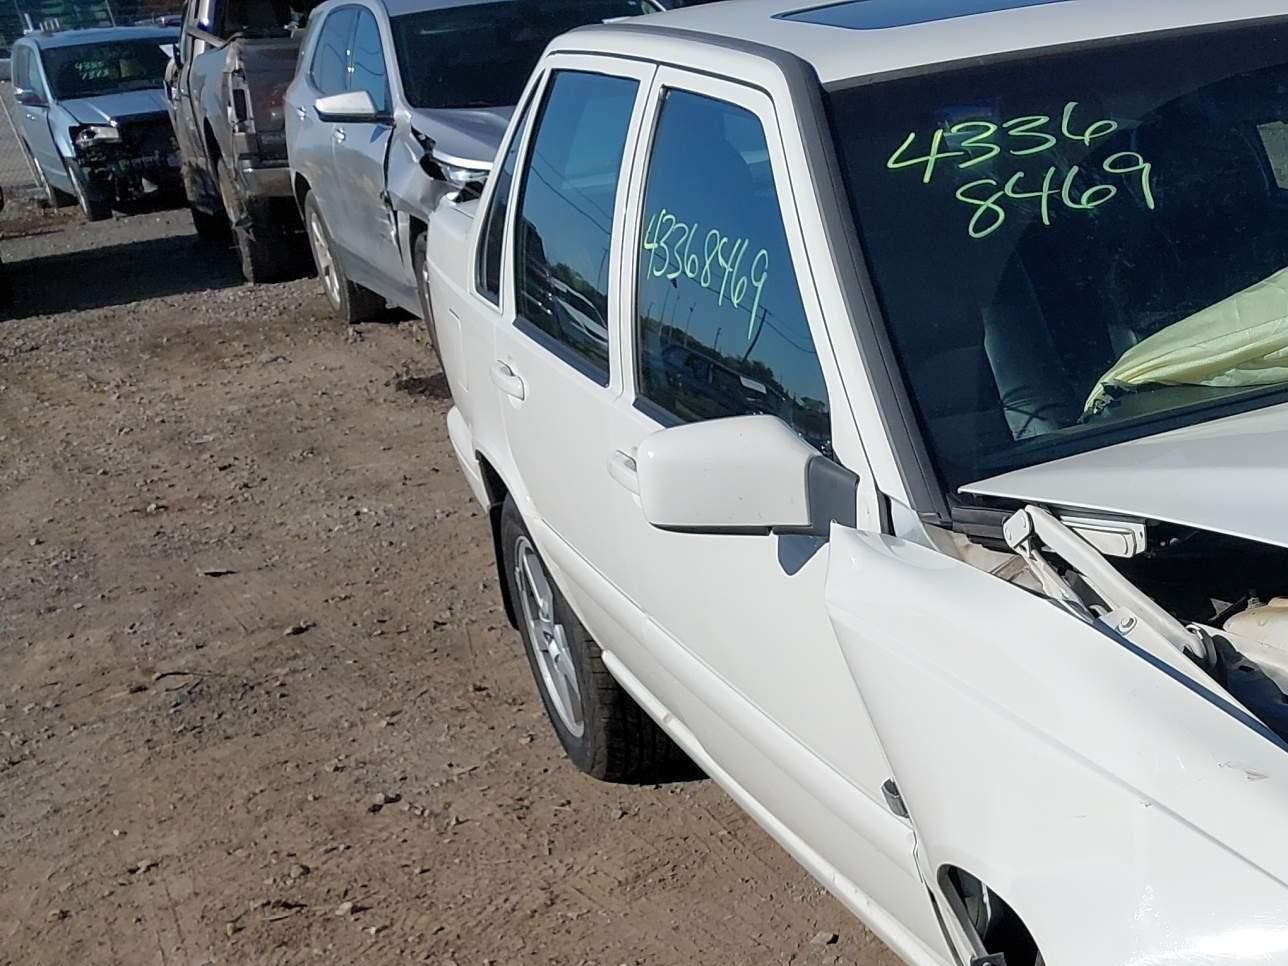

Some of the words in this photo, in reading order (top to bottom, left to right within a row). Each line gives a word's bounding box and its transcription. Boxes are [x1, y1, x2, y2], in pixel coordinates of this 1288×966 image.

[887, 102, 1118, 183] 4336
[955, 151, 1155, 238] 8469
[644, 209, 768, 340] 43368469
